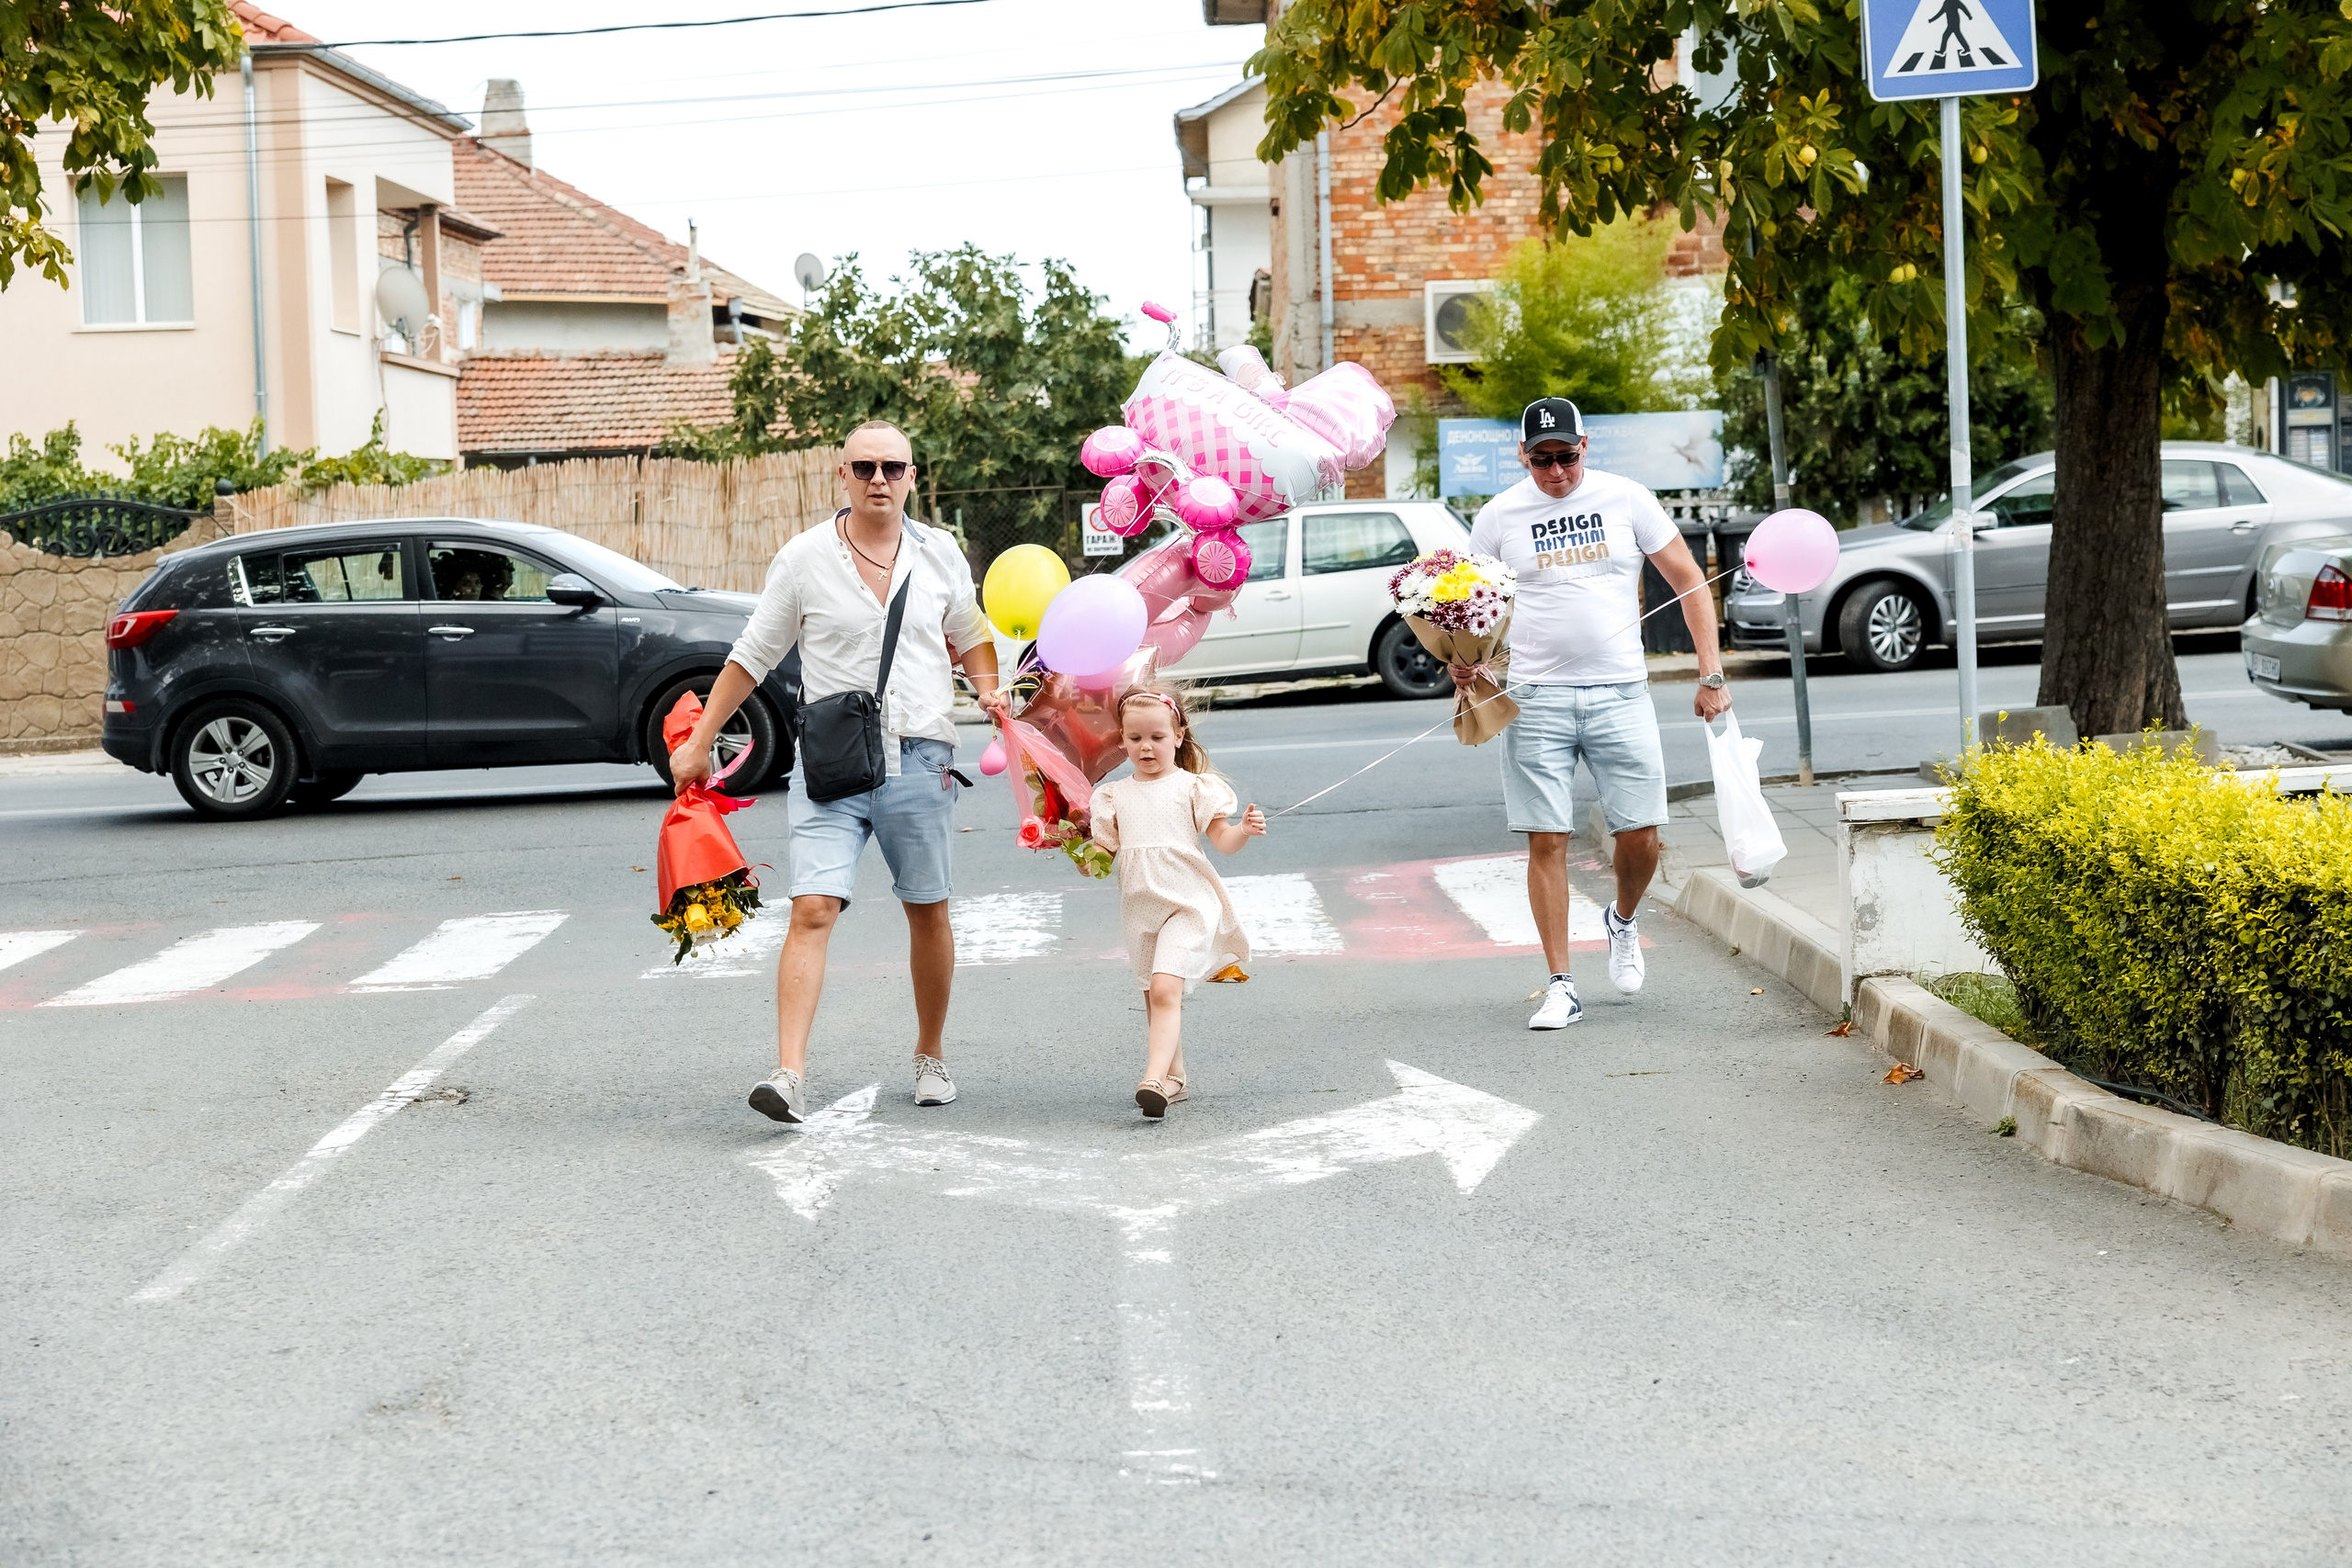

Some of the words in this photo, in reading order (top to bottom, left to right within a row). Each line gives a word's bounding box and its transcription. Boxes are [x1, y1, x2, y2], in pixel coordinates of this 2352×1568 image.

[1232, 402, 1287, 448] GIRL
[1539, 408, 1555, 428] LA
[1531, 513, 1603, 539] DESIGN
[1534, 528, 1606, 553] RHYTHM
[1536, 542, 1610, 570] DESIGN
